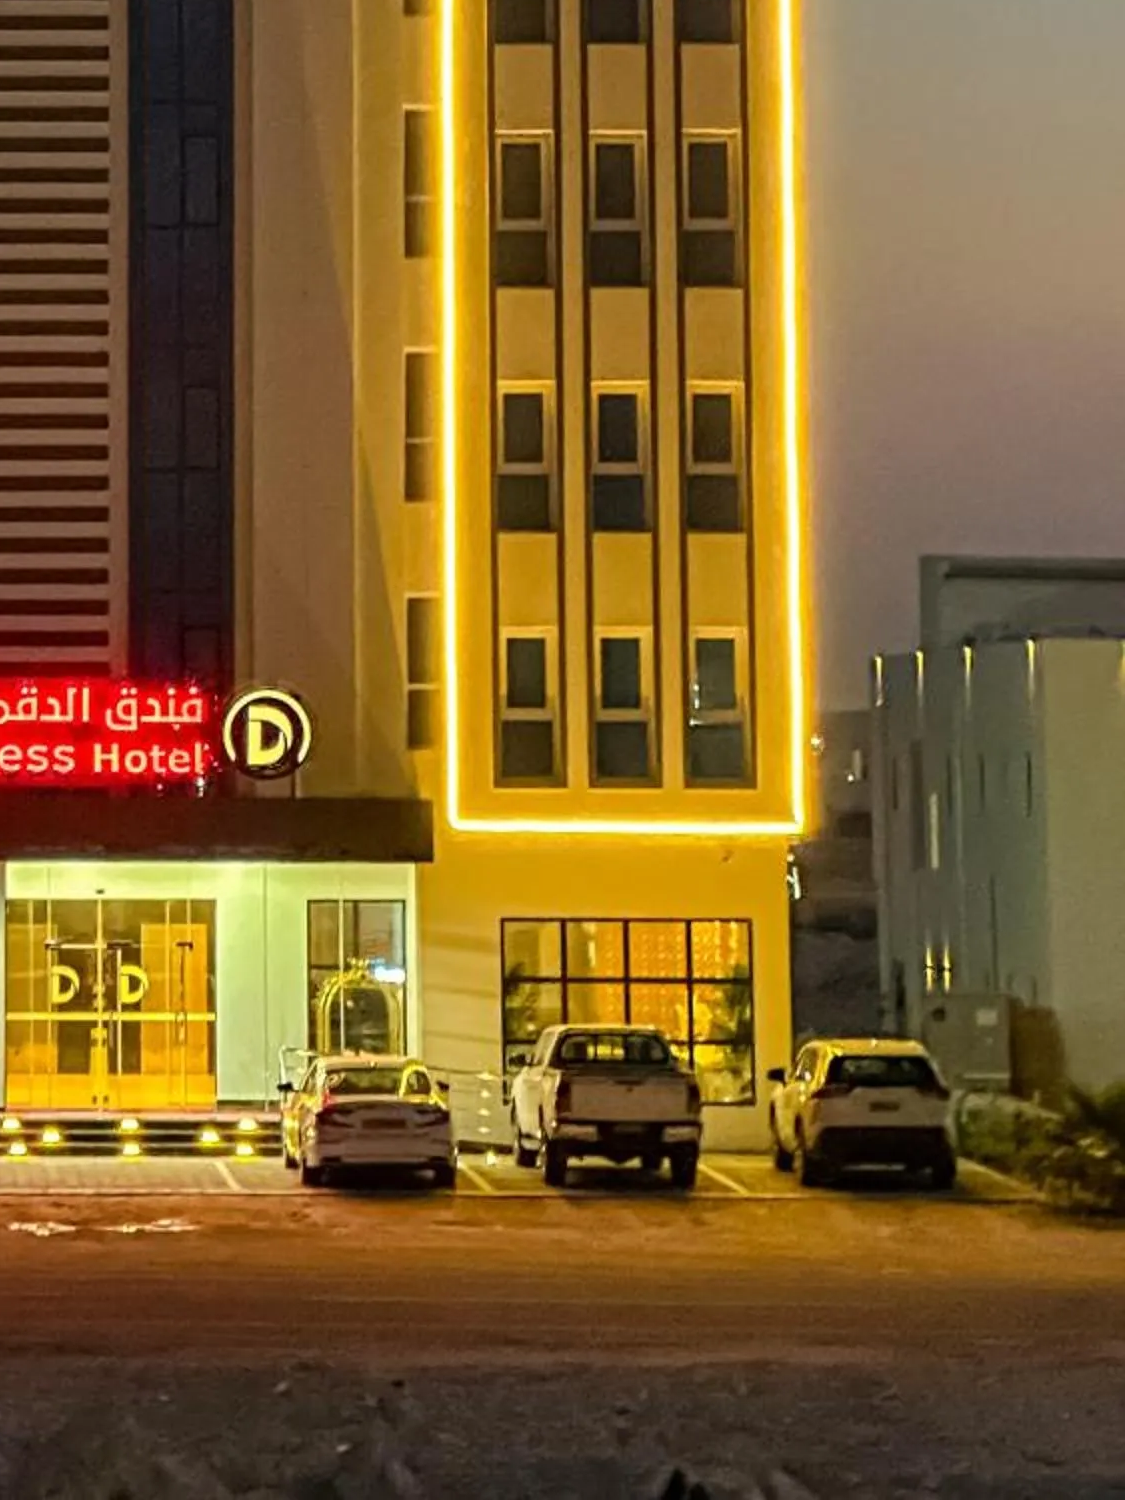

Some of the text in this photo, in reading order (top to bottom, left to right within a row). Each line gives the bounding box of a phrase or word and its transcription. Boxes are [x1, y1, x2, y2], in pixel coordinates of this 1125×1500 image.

[105, 686, 203, 731] فندق
[246, 704, 292, 767] D
[93, 741, 204, 774] Hotel
[51, 964, 80, 1003] D
[119, 964, 150, 1003] D
